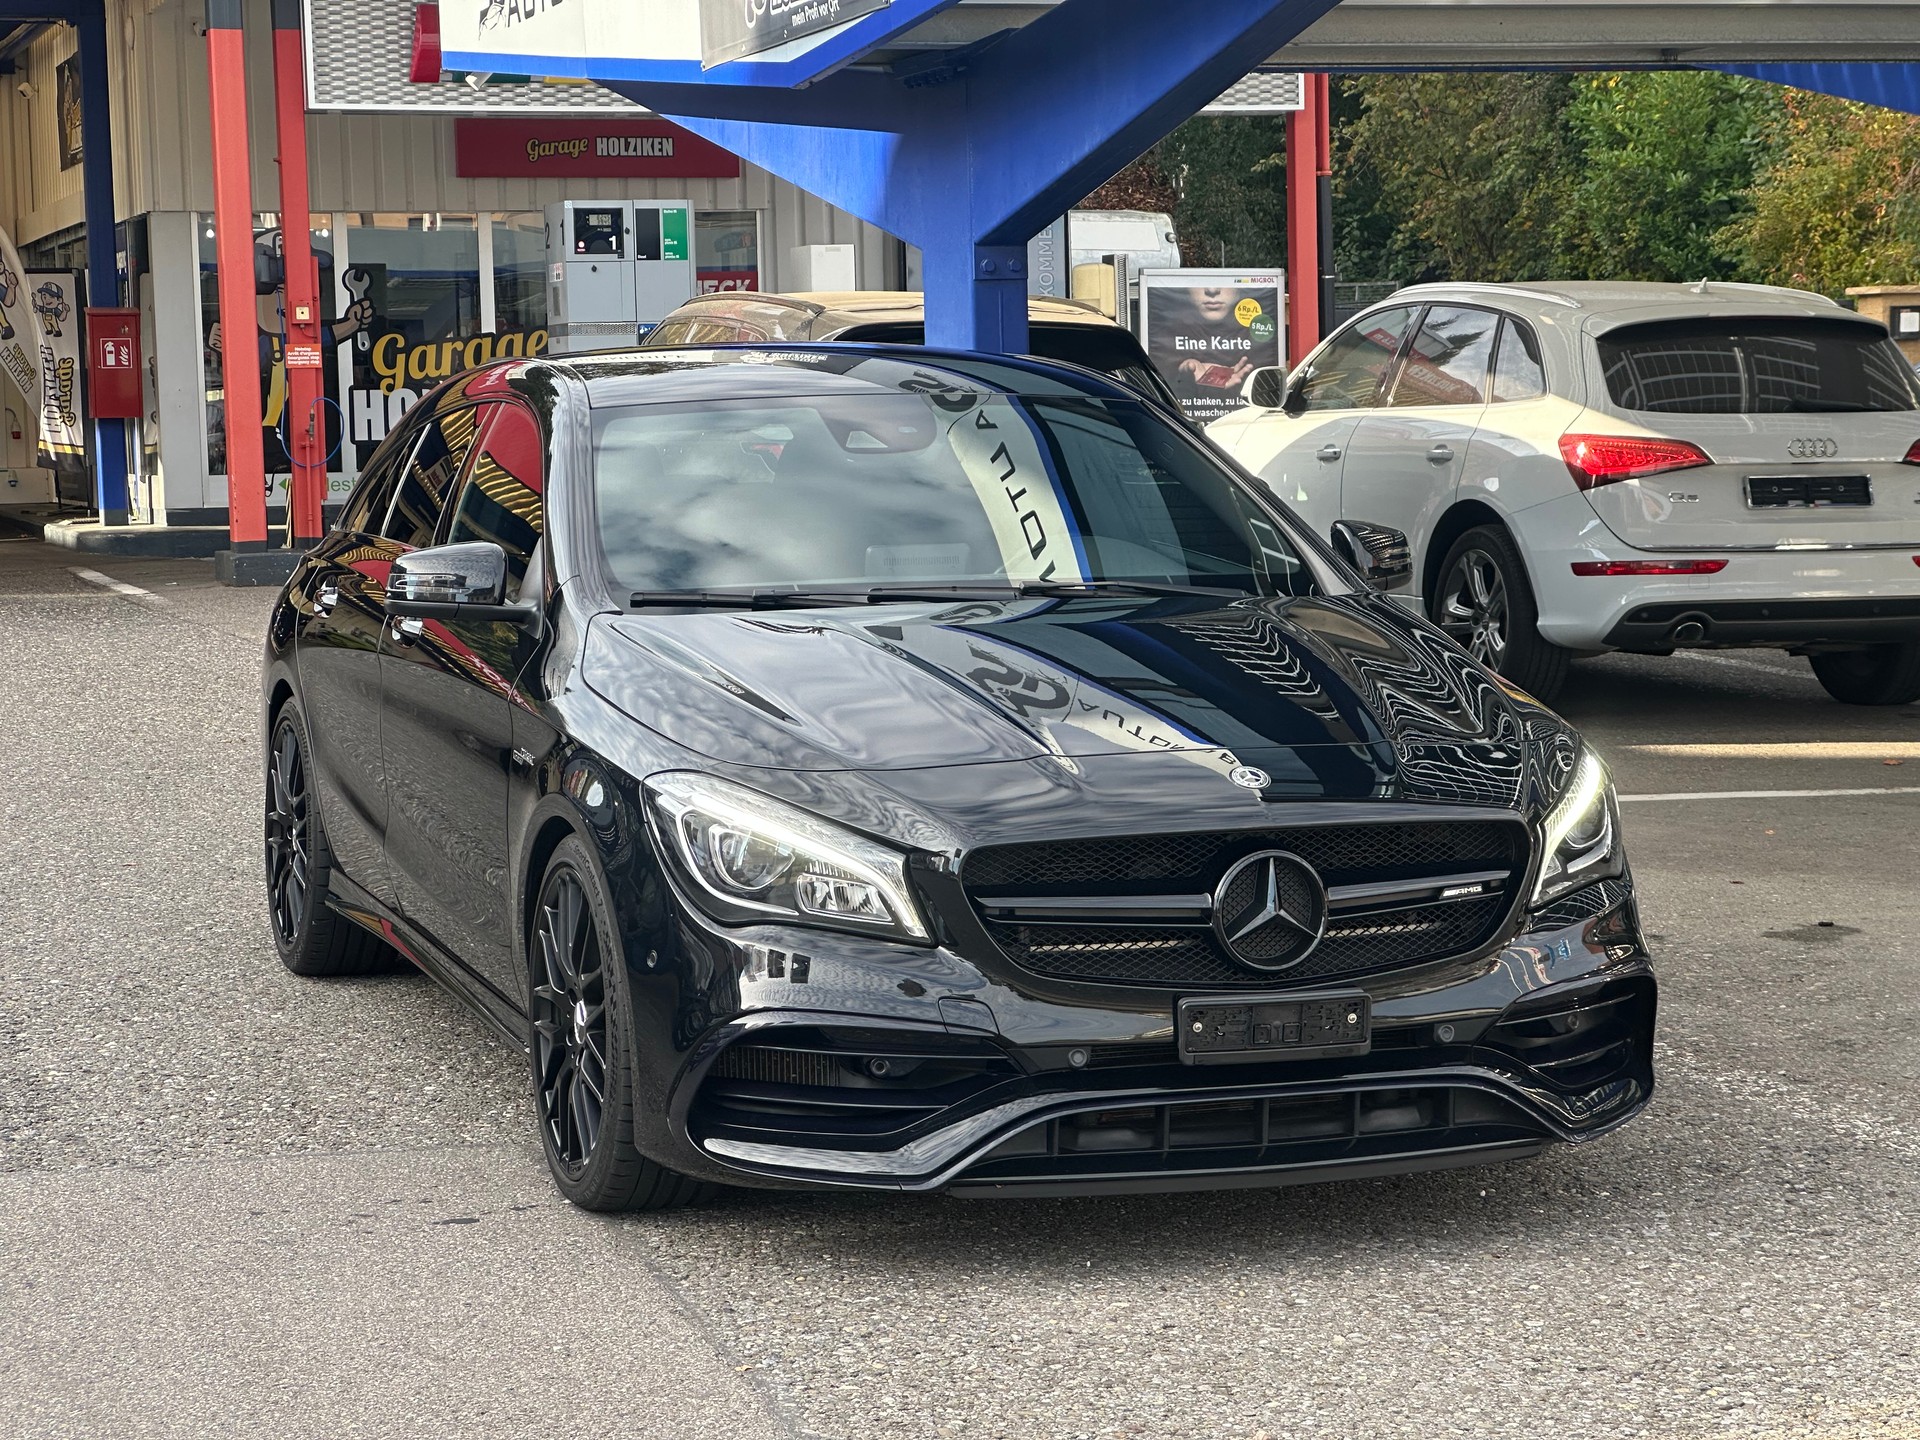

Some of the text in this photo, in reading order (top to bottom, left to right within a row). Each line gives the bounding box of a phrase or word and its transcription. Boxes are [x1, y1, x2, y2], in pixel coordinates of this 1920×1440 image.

[804, 2, 819, 22] Profi
[818, 2, 828, 17] vor
[527, 137, 674, 161] Garage HOLZIKEN
[609, 235, 617, 250] 1
[1038, 226, 1054, 297] KOMME
[1175, 336, 1251, 350] Eine Karte
[372, 328, 549, 396] Garage
[1182, 396, 1246, 407] zu tanken, zu la
[353, 386, 426, 442] HO
[1194, 408, 1230, 417] waschen
[1669, 490, 1700, 503] Q5
[1455, 885, 1483, 895] AMG
